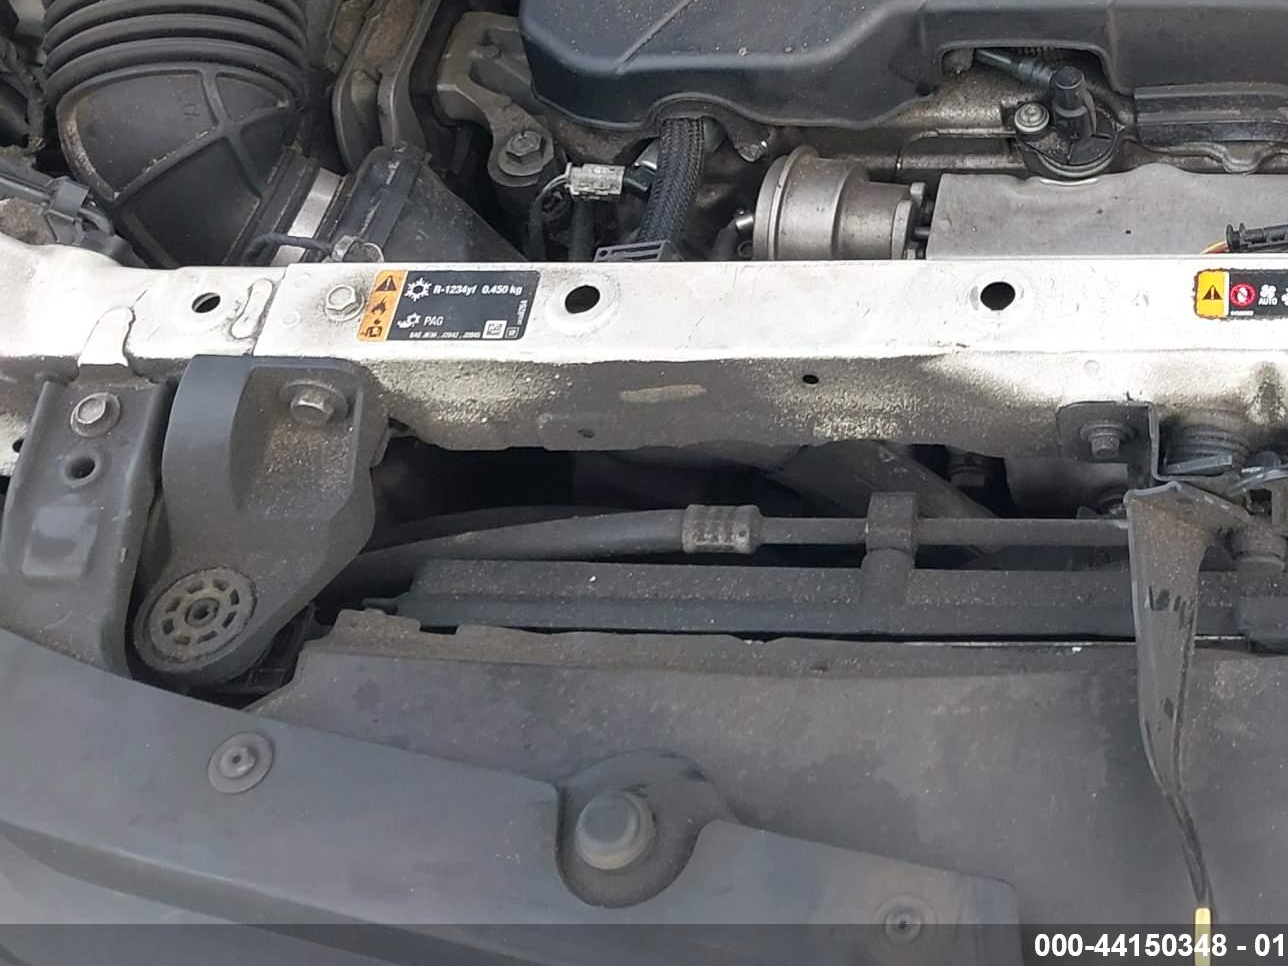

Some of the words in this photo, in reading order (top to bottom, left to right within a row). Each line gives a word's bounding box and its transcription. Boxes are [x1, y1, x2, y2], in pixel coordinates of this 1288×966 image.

[433, 284, 477, 296] R-1234yf
[482, 284, 508, 294] 0.450
[509, 284, 523, 296] kg
[1258, 297, 1278, 306] AUTO
[423, 315, 444, 326] PAG
